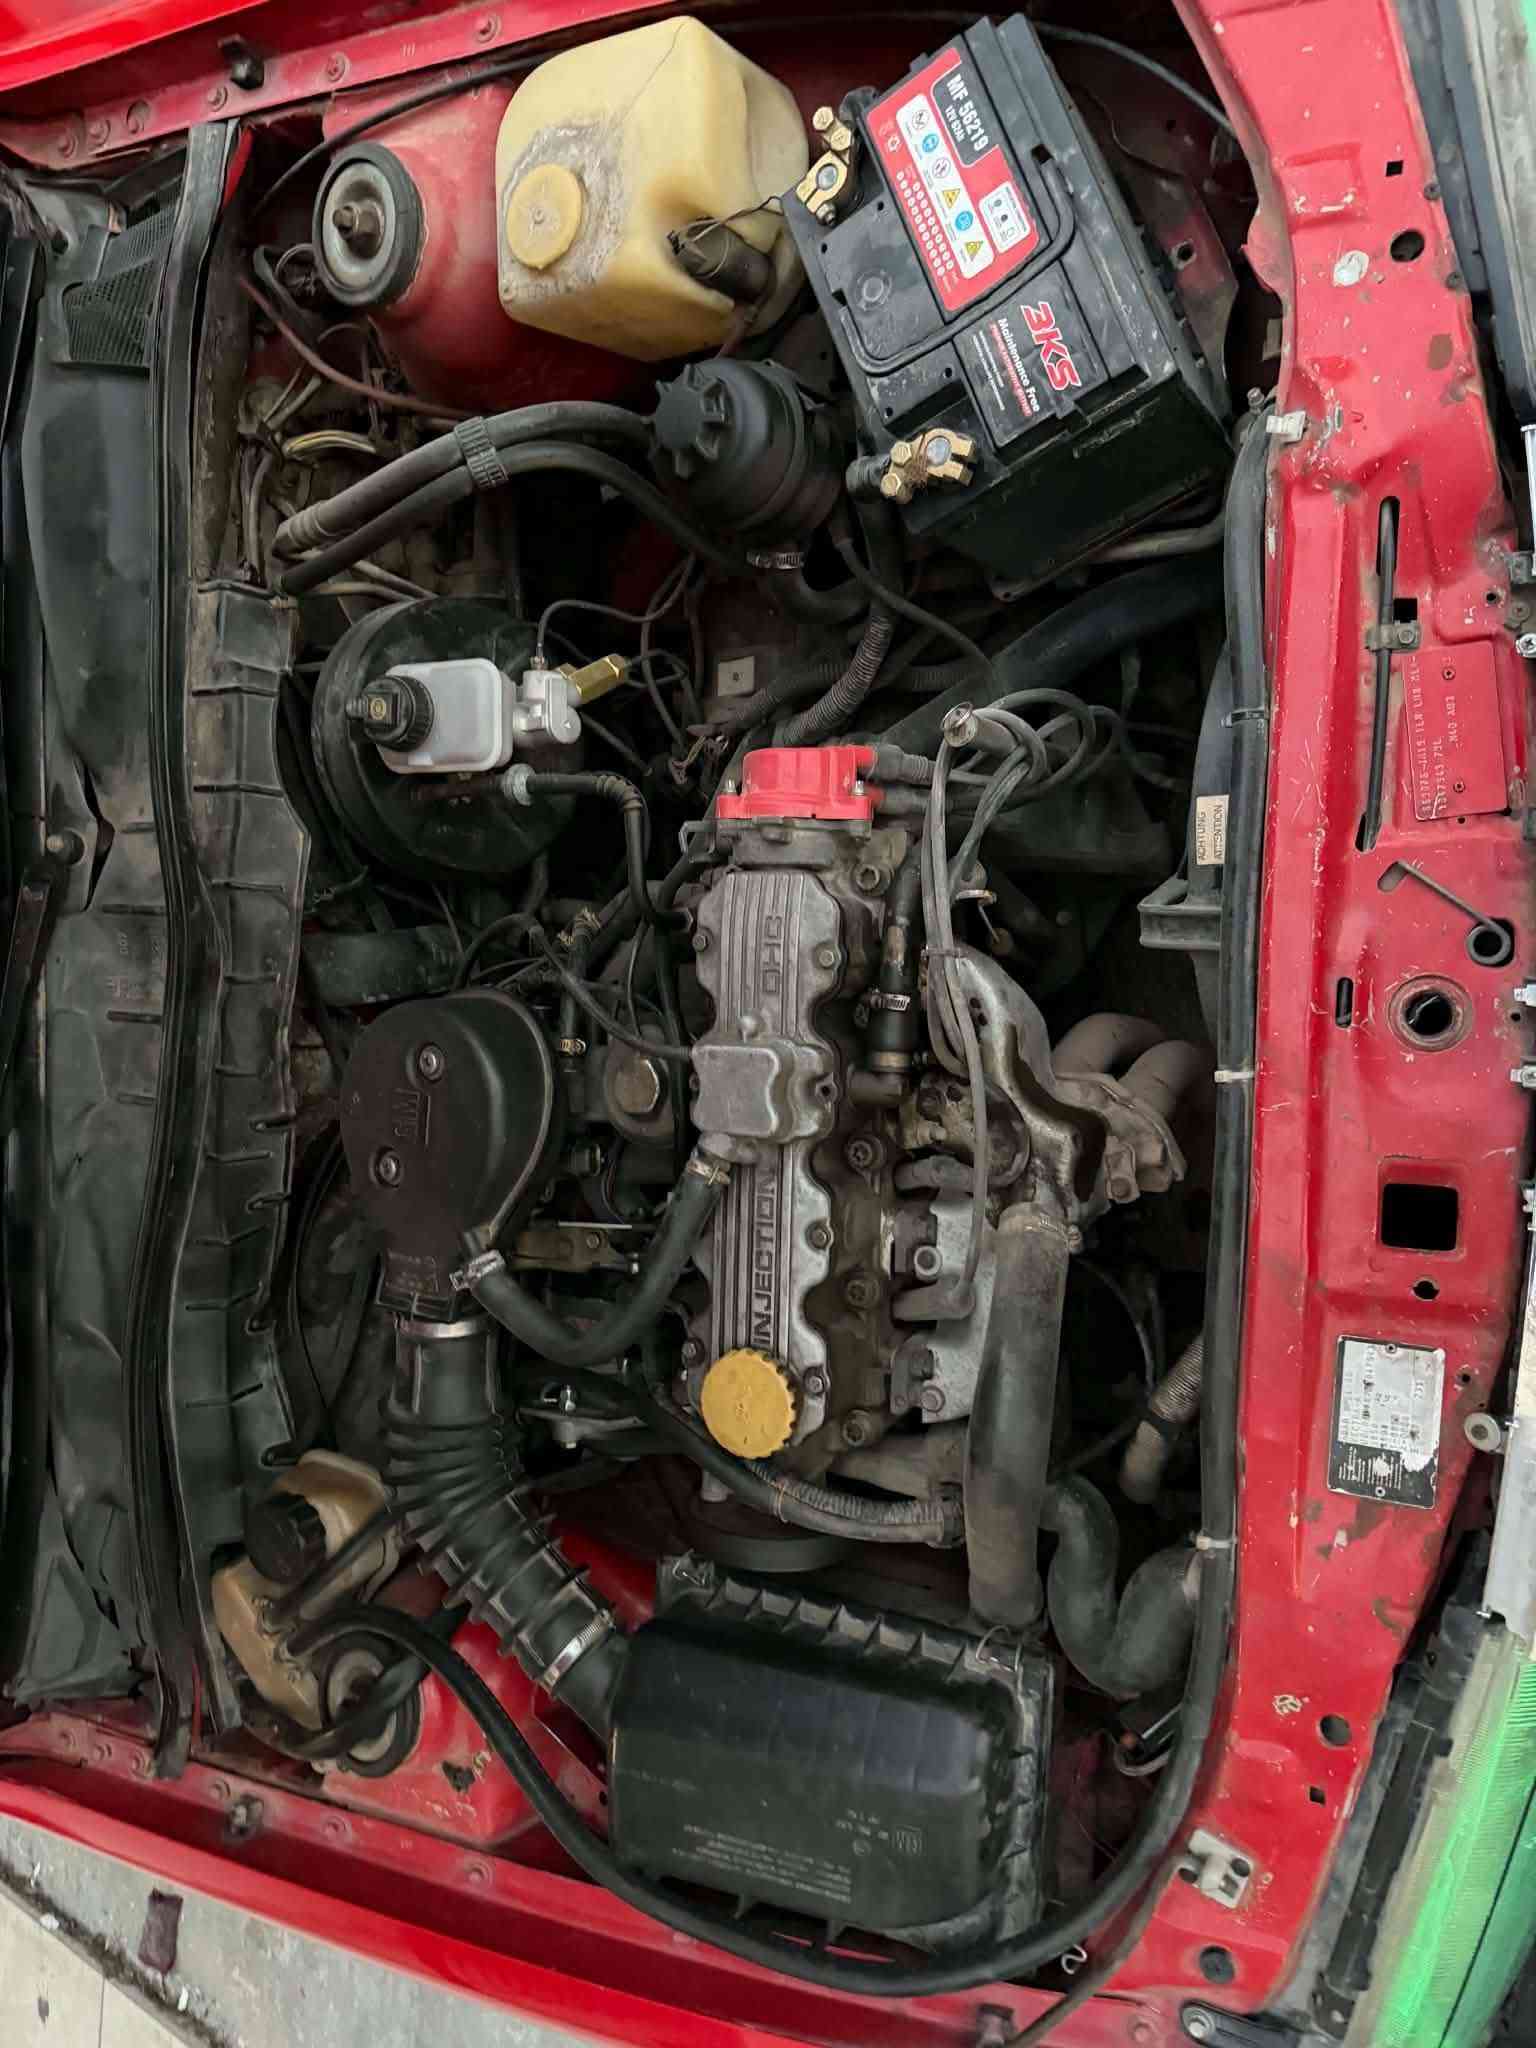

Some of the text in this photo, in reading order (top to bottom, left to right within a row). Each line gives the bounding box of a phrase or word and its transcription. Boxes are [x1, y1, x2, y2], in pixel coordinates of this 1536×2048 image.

[946, 73, 989, 152] MF 56219
[998, 318, 1030, 387] Maintenance
[1025, 384, 1040, 412] Free
[762, 915, 782, 995] OHC
[753, 1167, 776, 1346] INJECTION
